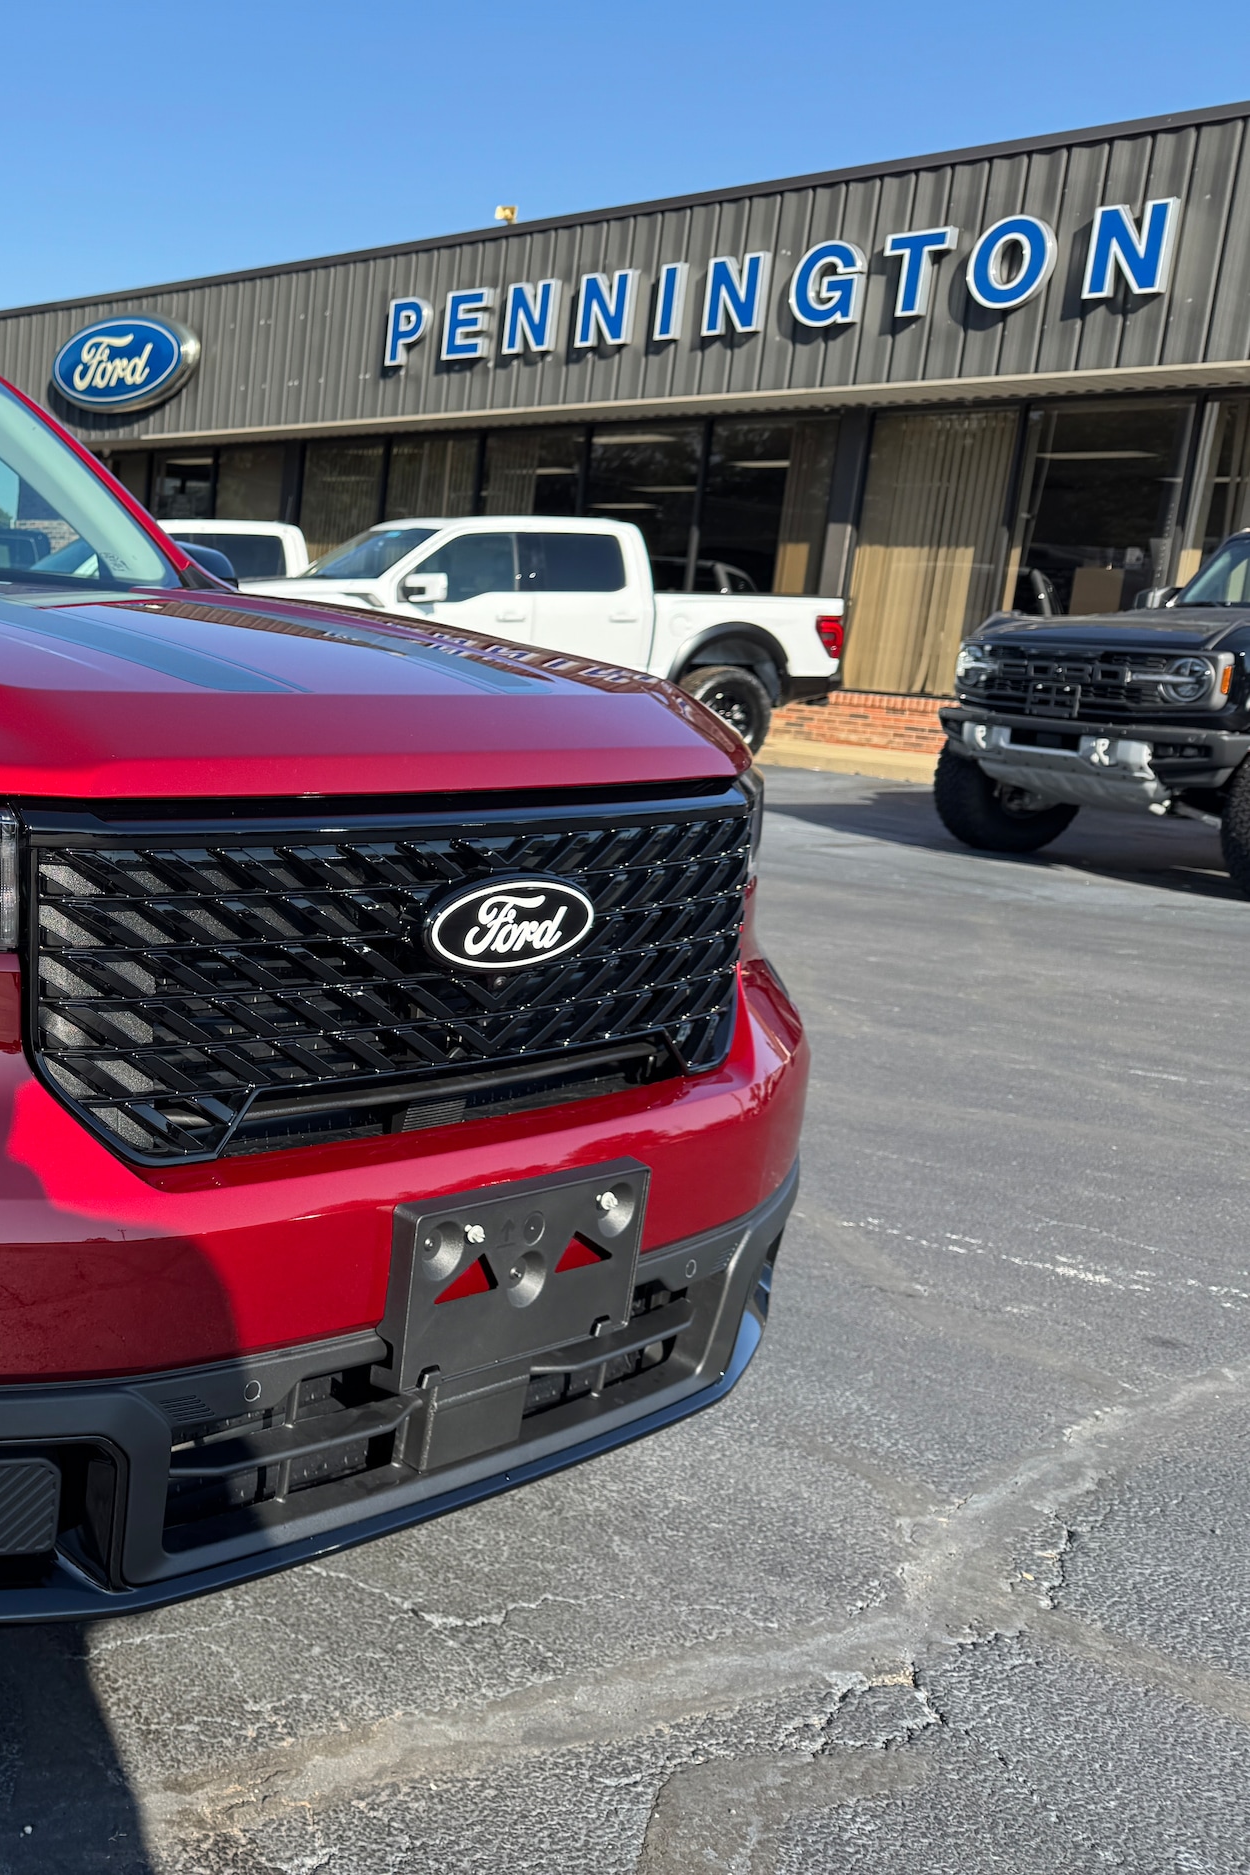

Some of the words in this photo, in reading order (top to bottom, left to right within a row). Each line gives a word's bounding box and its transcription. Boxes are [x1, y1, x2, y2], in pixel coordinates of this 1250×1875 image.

[383, 196, 1182, 368] PENNINGTON
[72, 332, 154, 392] Ford
[463, 894, 568, 956] Ford
